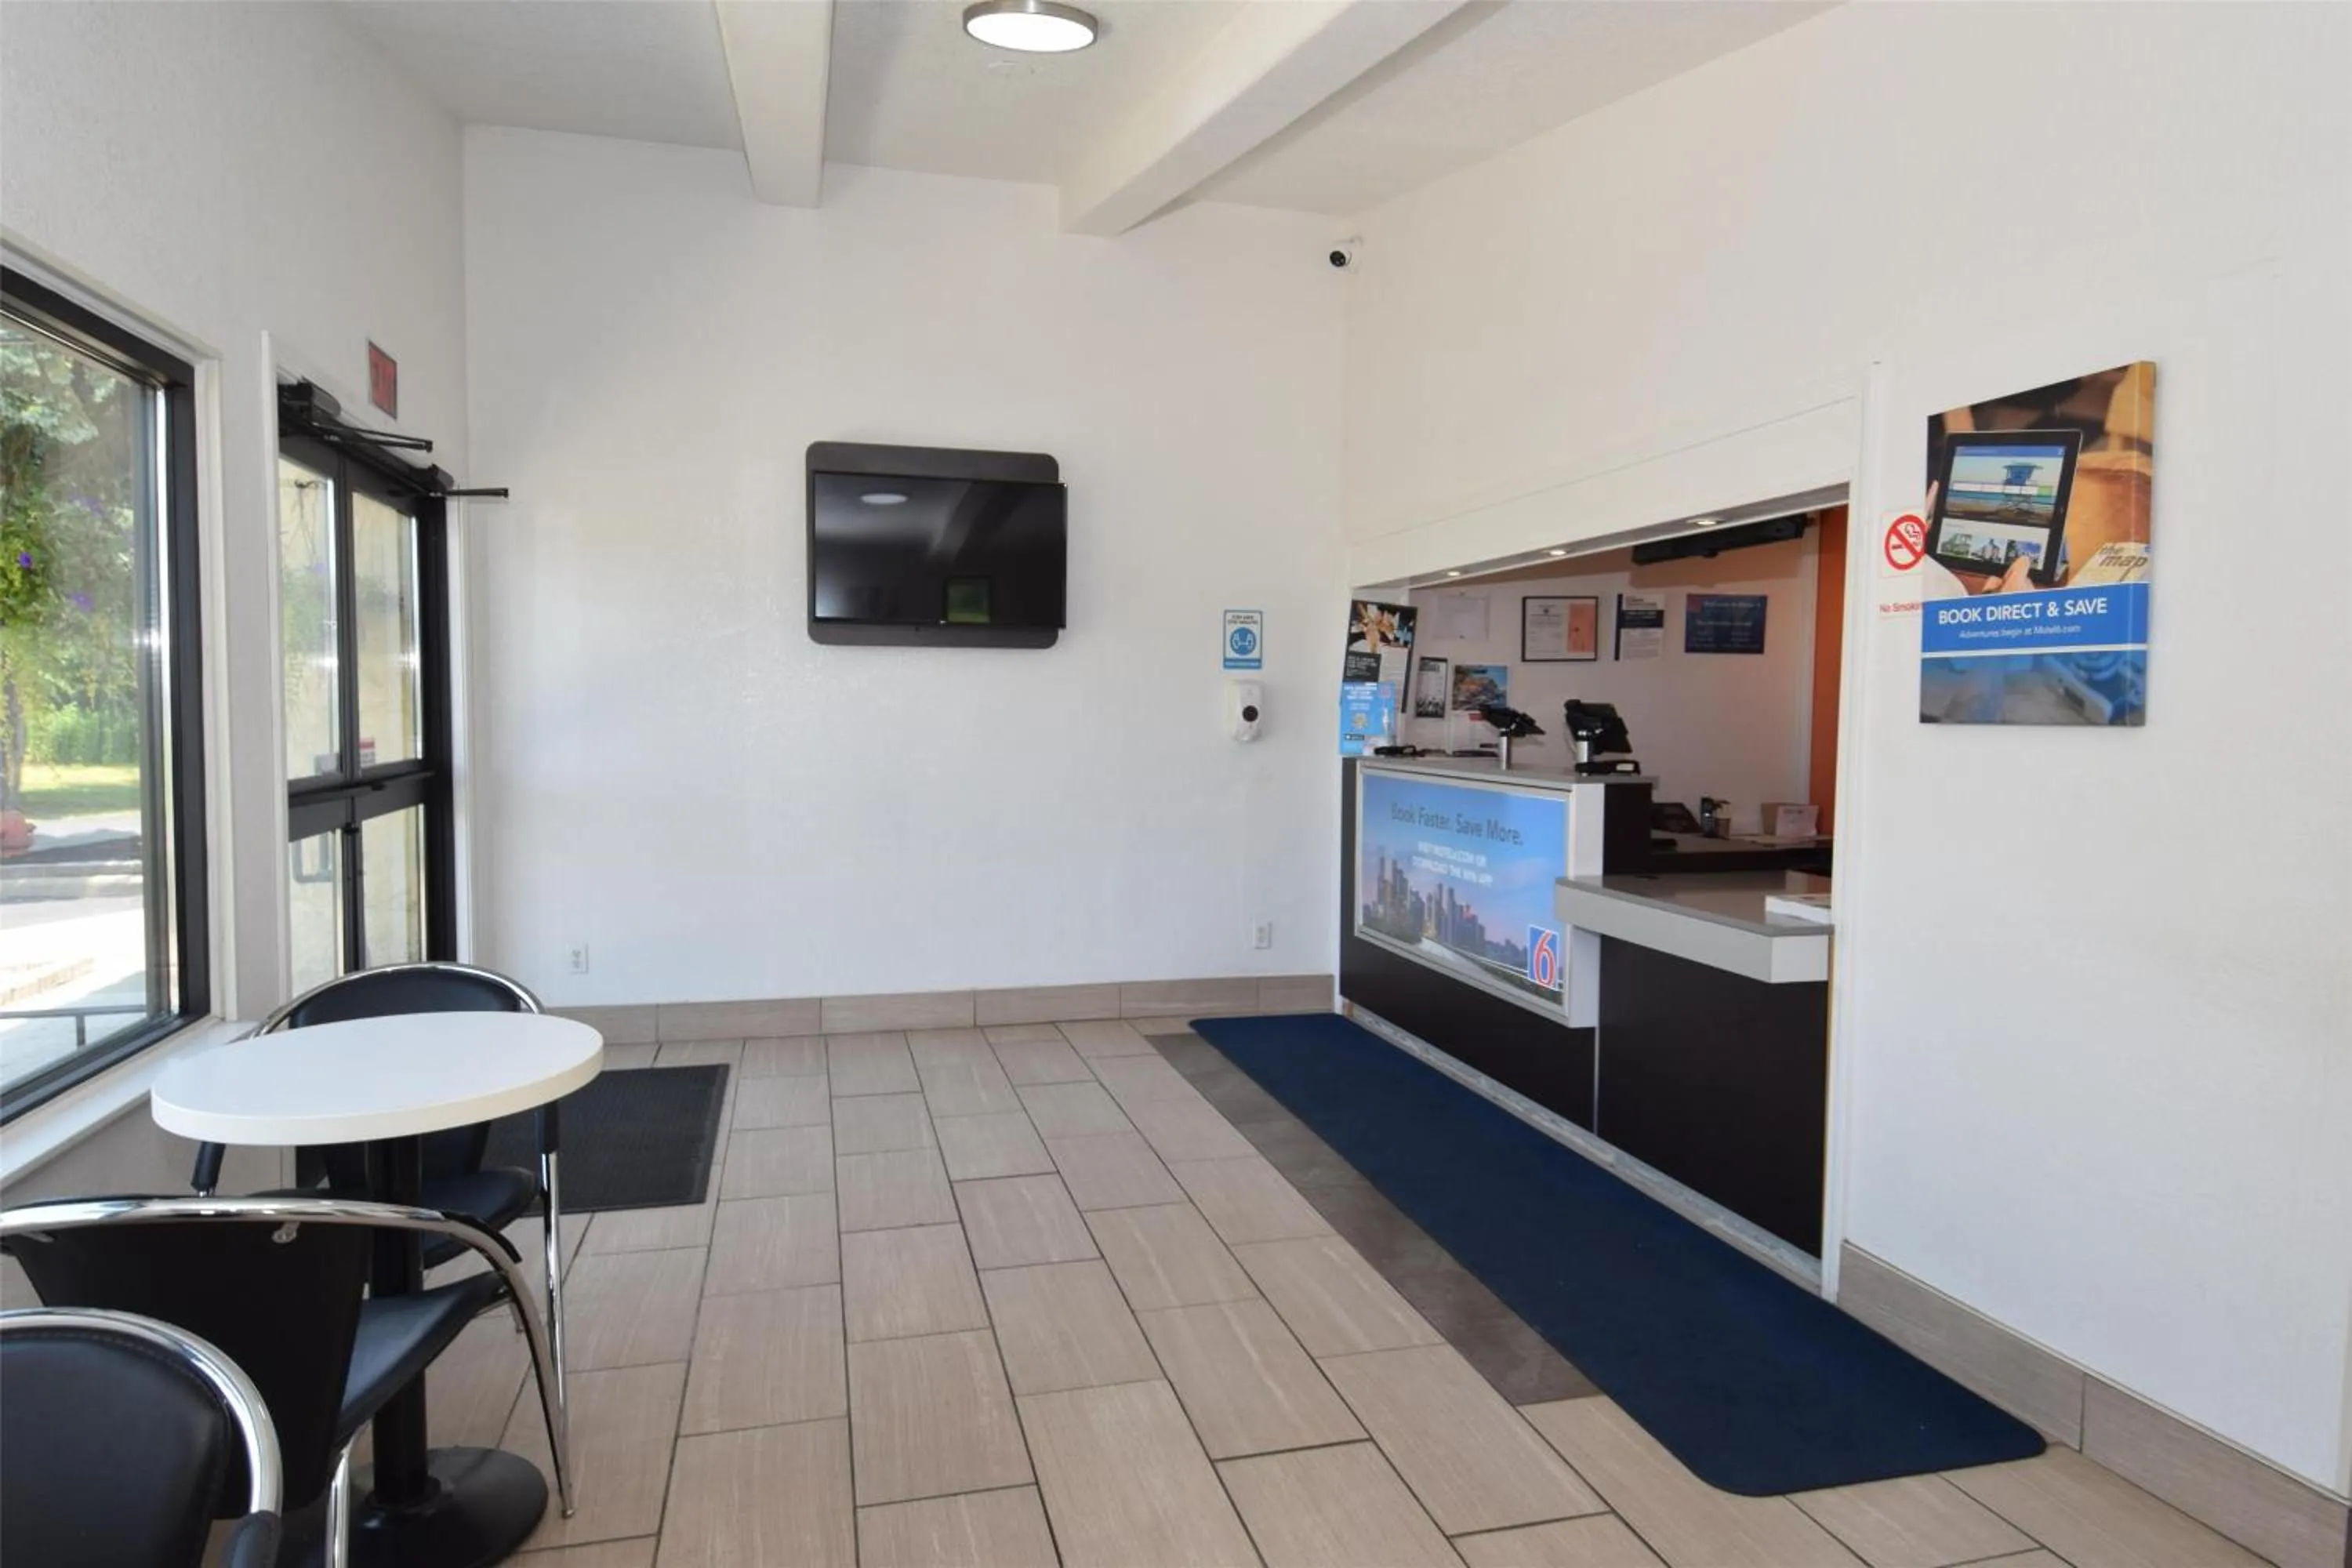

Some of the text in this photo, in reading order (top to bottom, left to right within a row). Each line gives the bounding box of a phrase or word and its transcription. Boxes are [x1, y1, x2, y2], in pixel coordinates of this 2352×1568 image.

[2099, 555, 2147, 582] map
[1893, 601, 1921, 612] Smokin
[1938, 597, 2108, 625] BOOK DIRECT & SAVE
[1391, 801, 1416, 824] Book
[1454, 813, 1483, 838] Save
[1486, 818, 1524, 847] More.
[1534, 930, 1556, 986] 6
